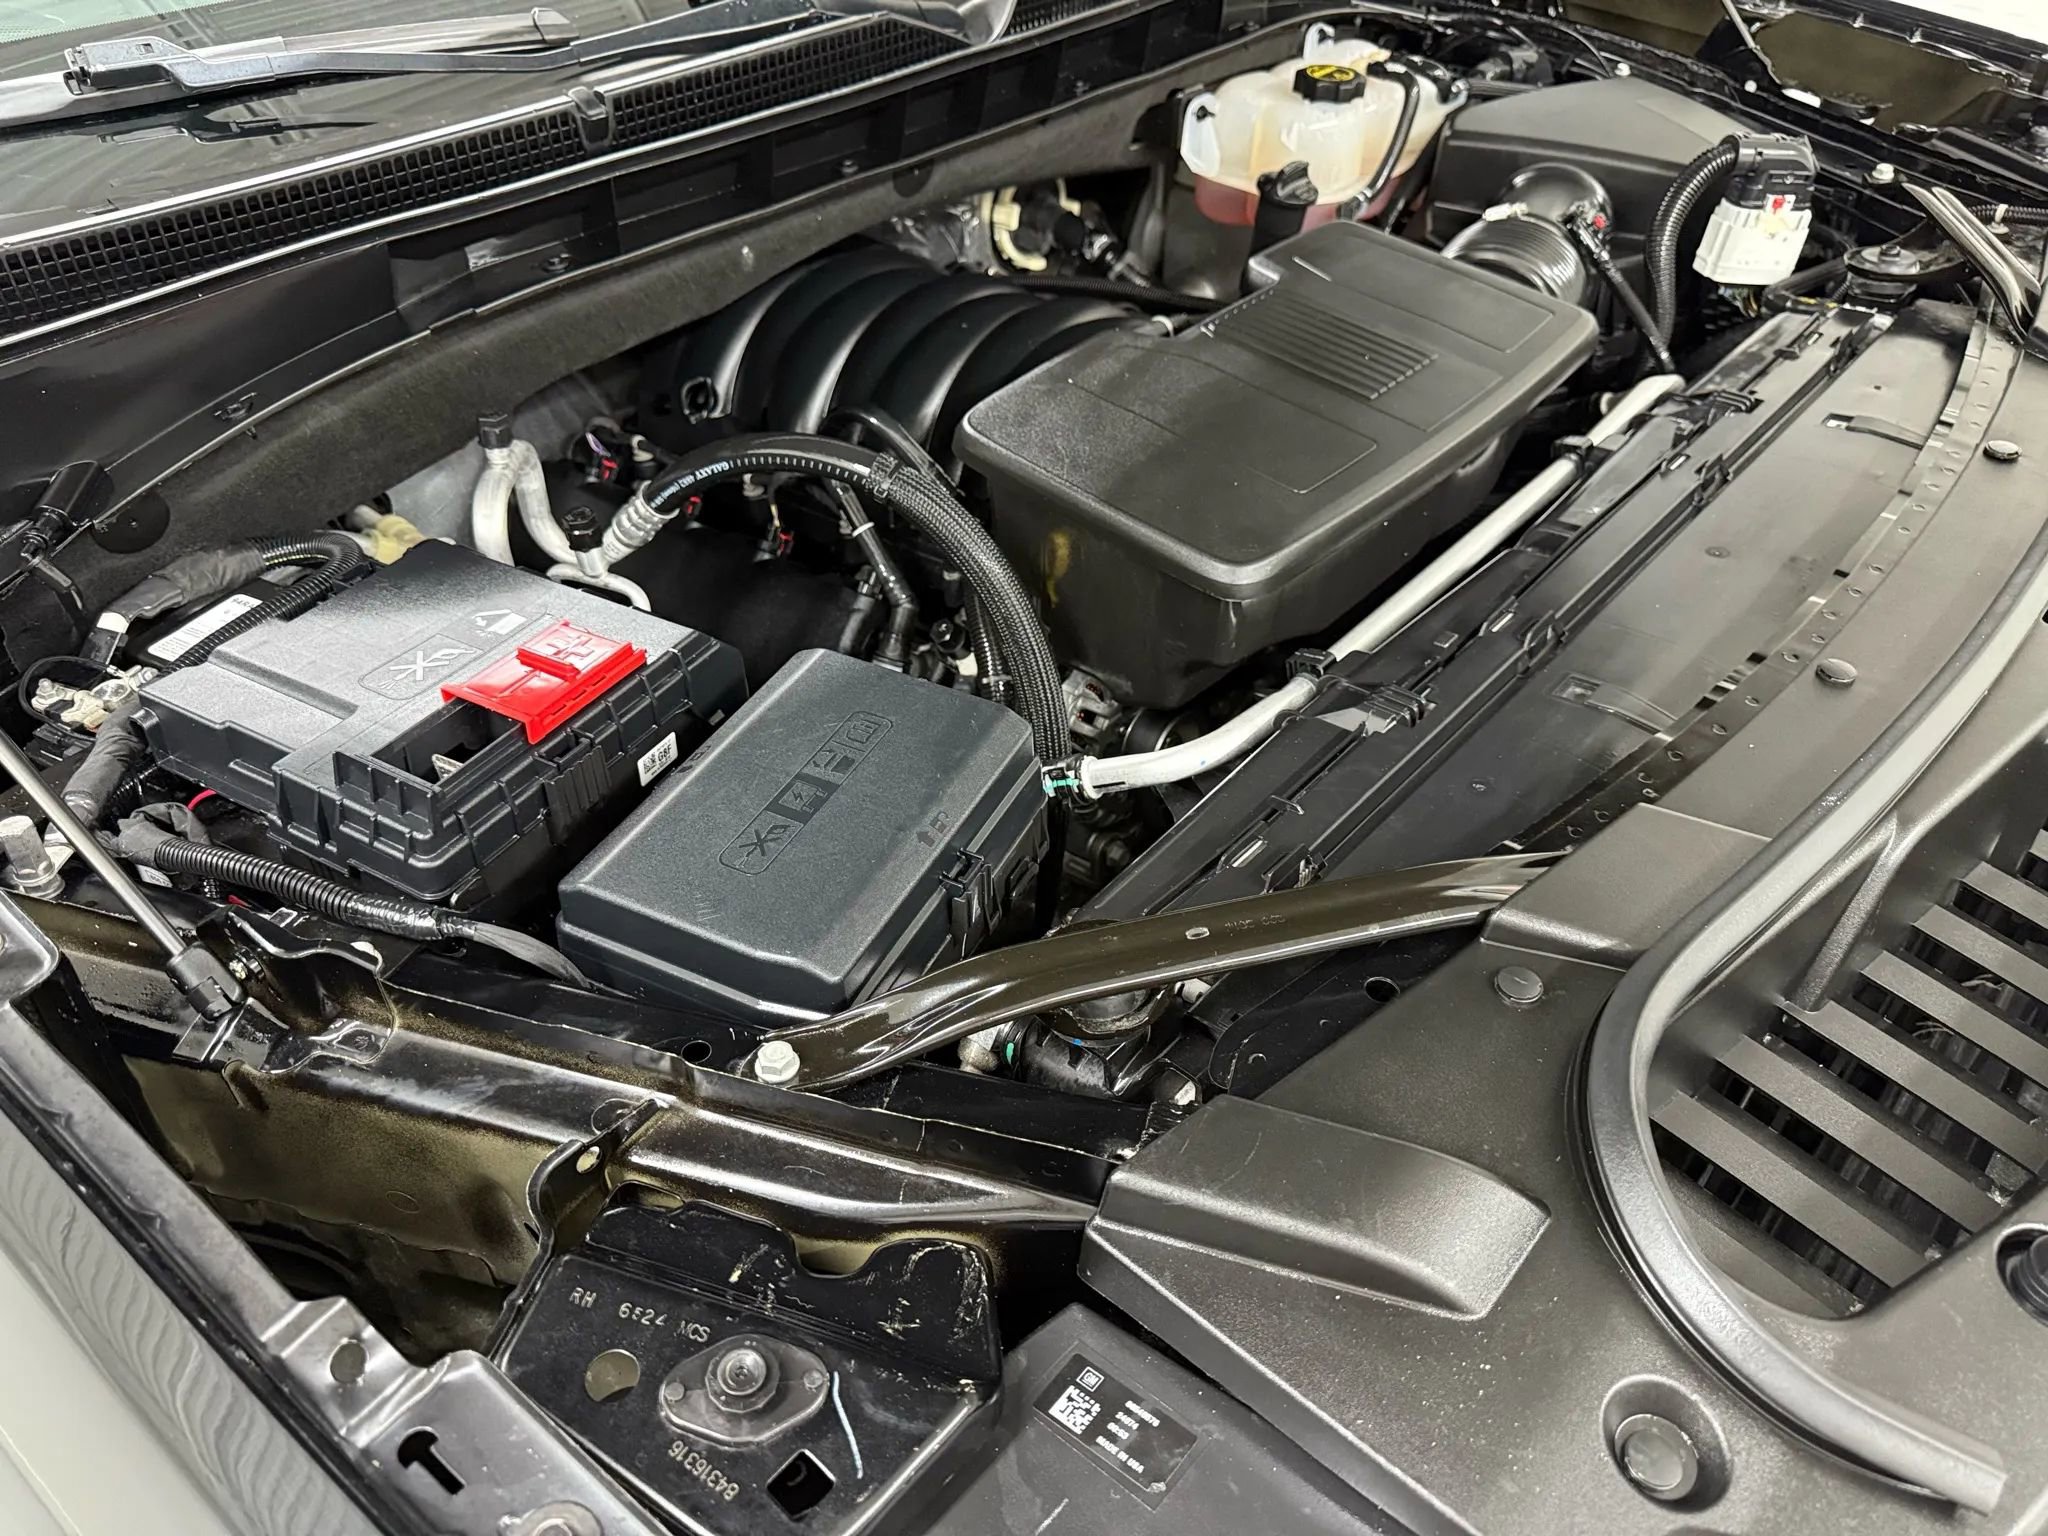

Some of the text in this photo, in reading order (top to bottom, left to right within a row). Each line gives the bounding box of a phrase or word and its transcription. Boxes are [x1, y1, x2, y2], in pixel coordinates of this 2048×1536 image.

[694, 461, 730, 480] GALAXY
[569, 1287, 597, 1309] RH
[1096, 1435, 1145, 1474] MADE IN USA
[668, 1440, 740, 1501] 84316316
